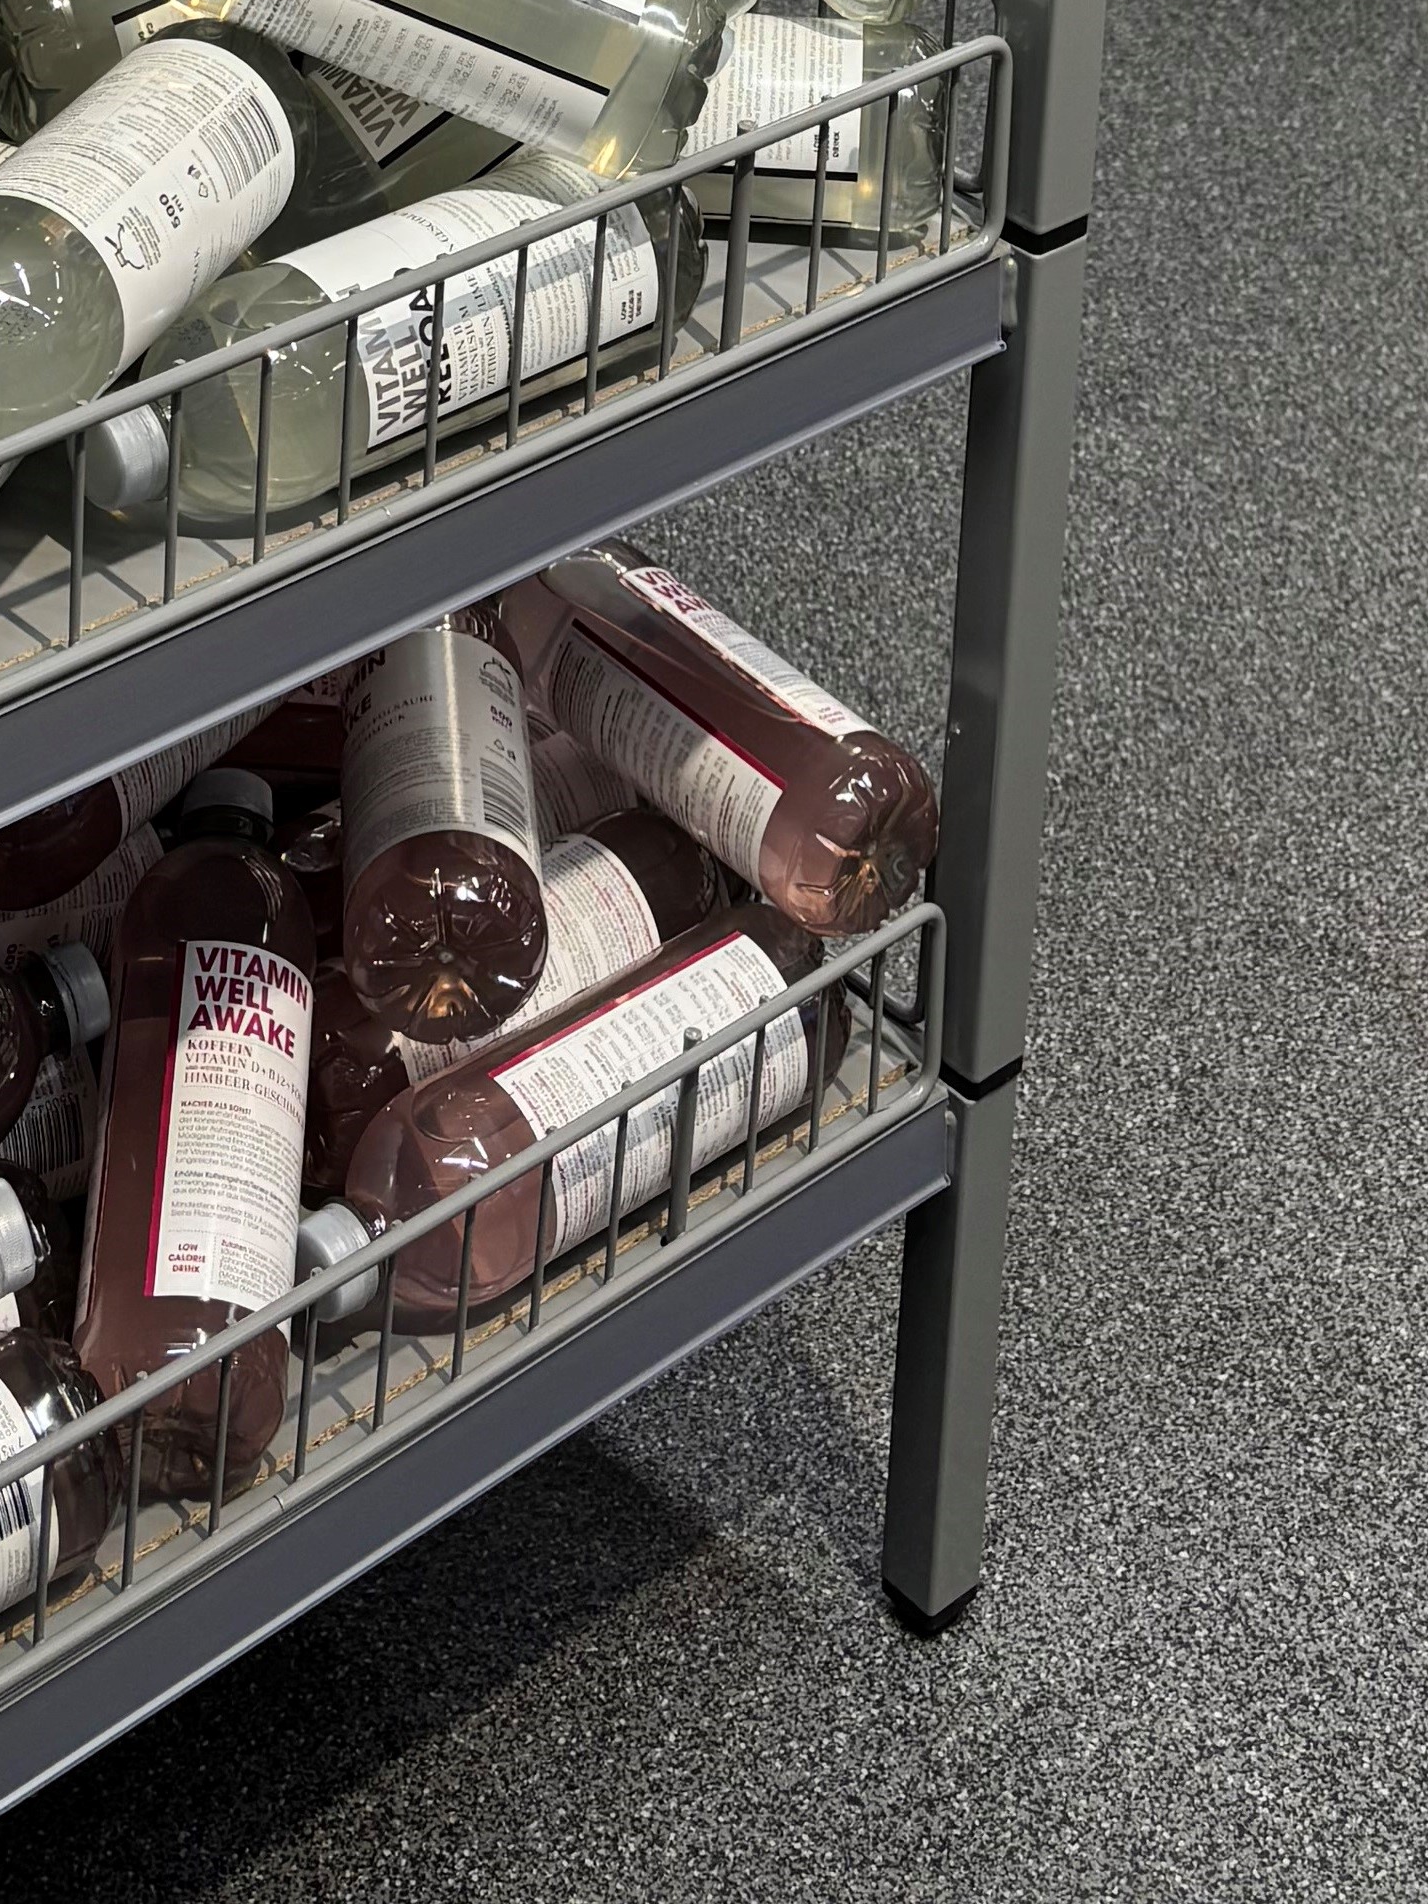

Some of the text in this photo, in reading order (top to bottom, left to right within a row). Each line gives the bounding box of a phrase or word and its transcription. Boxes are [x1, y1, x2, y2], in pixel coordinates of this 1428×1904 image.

[194, 975, 274, 1015] WELL
[195, 946, 308, 1014] VITAMIN
[187, 1003, 297, 1060] AWAKE
[187, 1038, 253, 1058] KOFFEIN
[185, 1052, 246, 1071] VITAMIN
